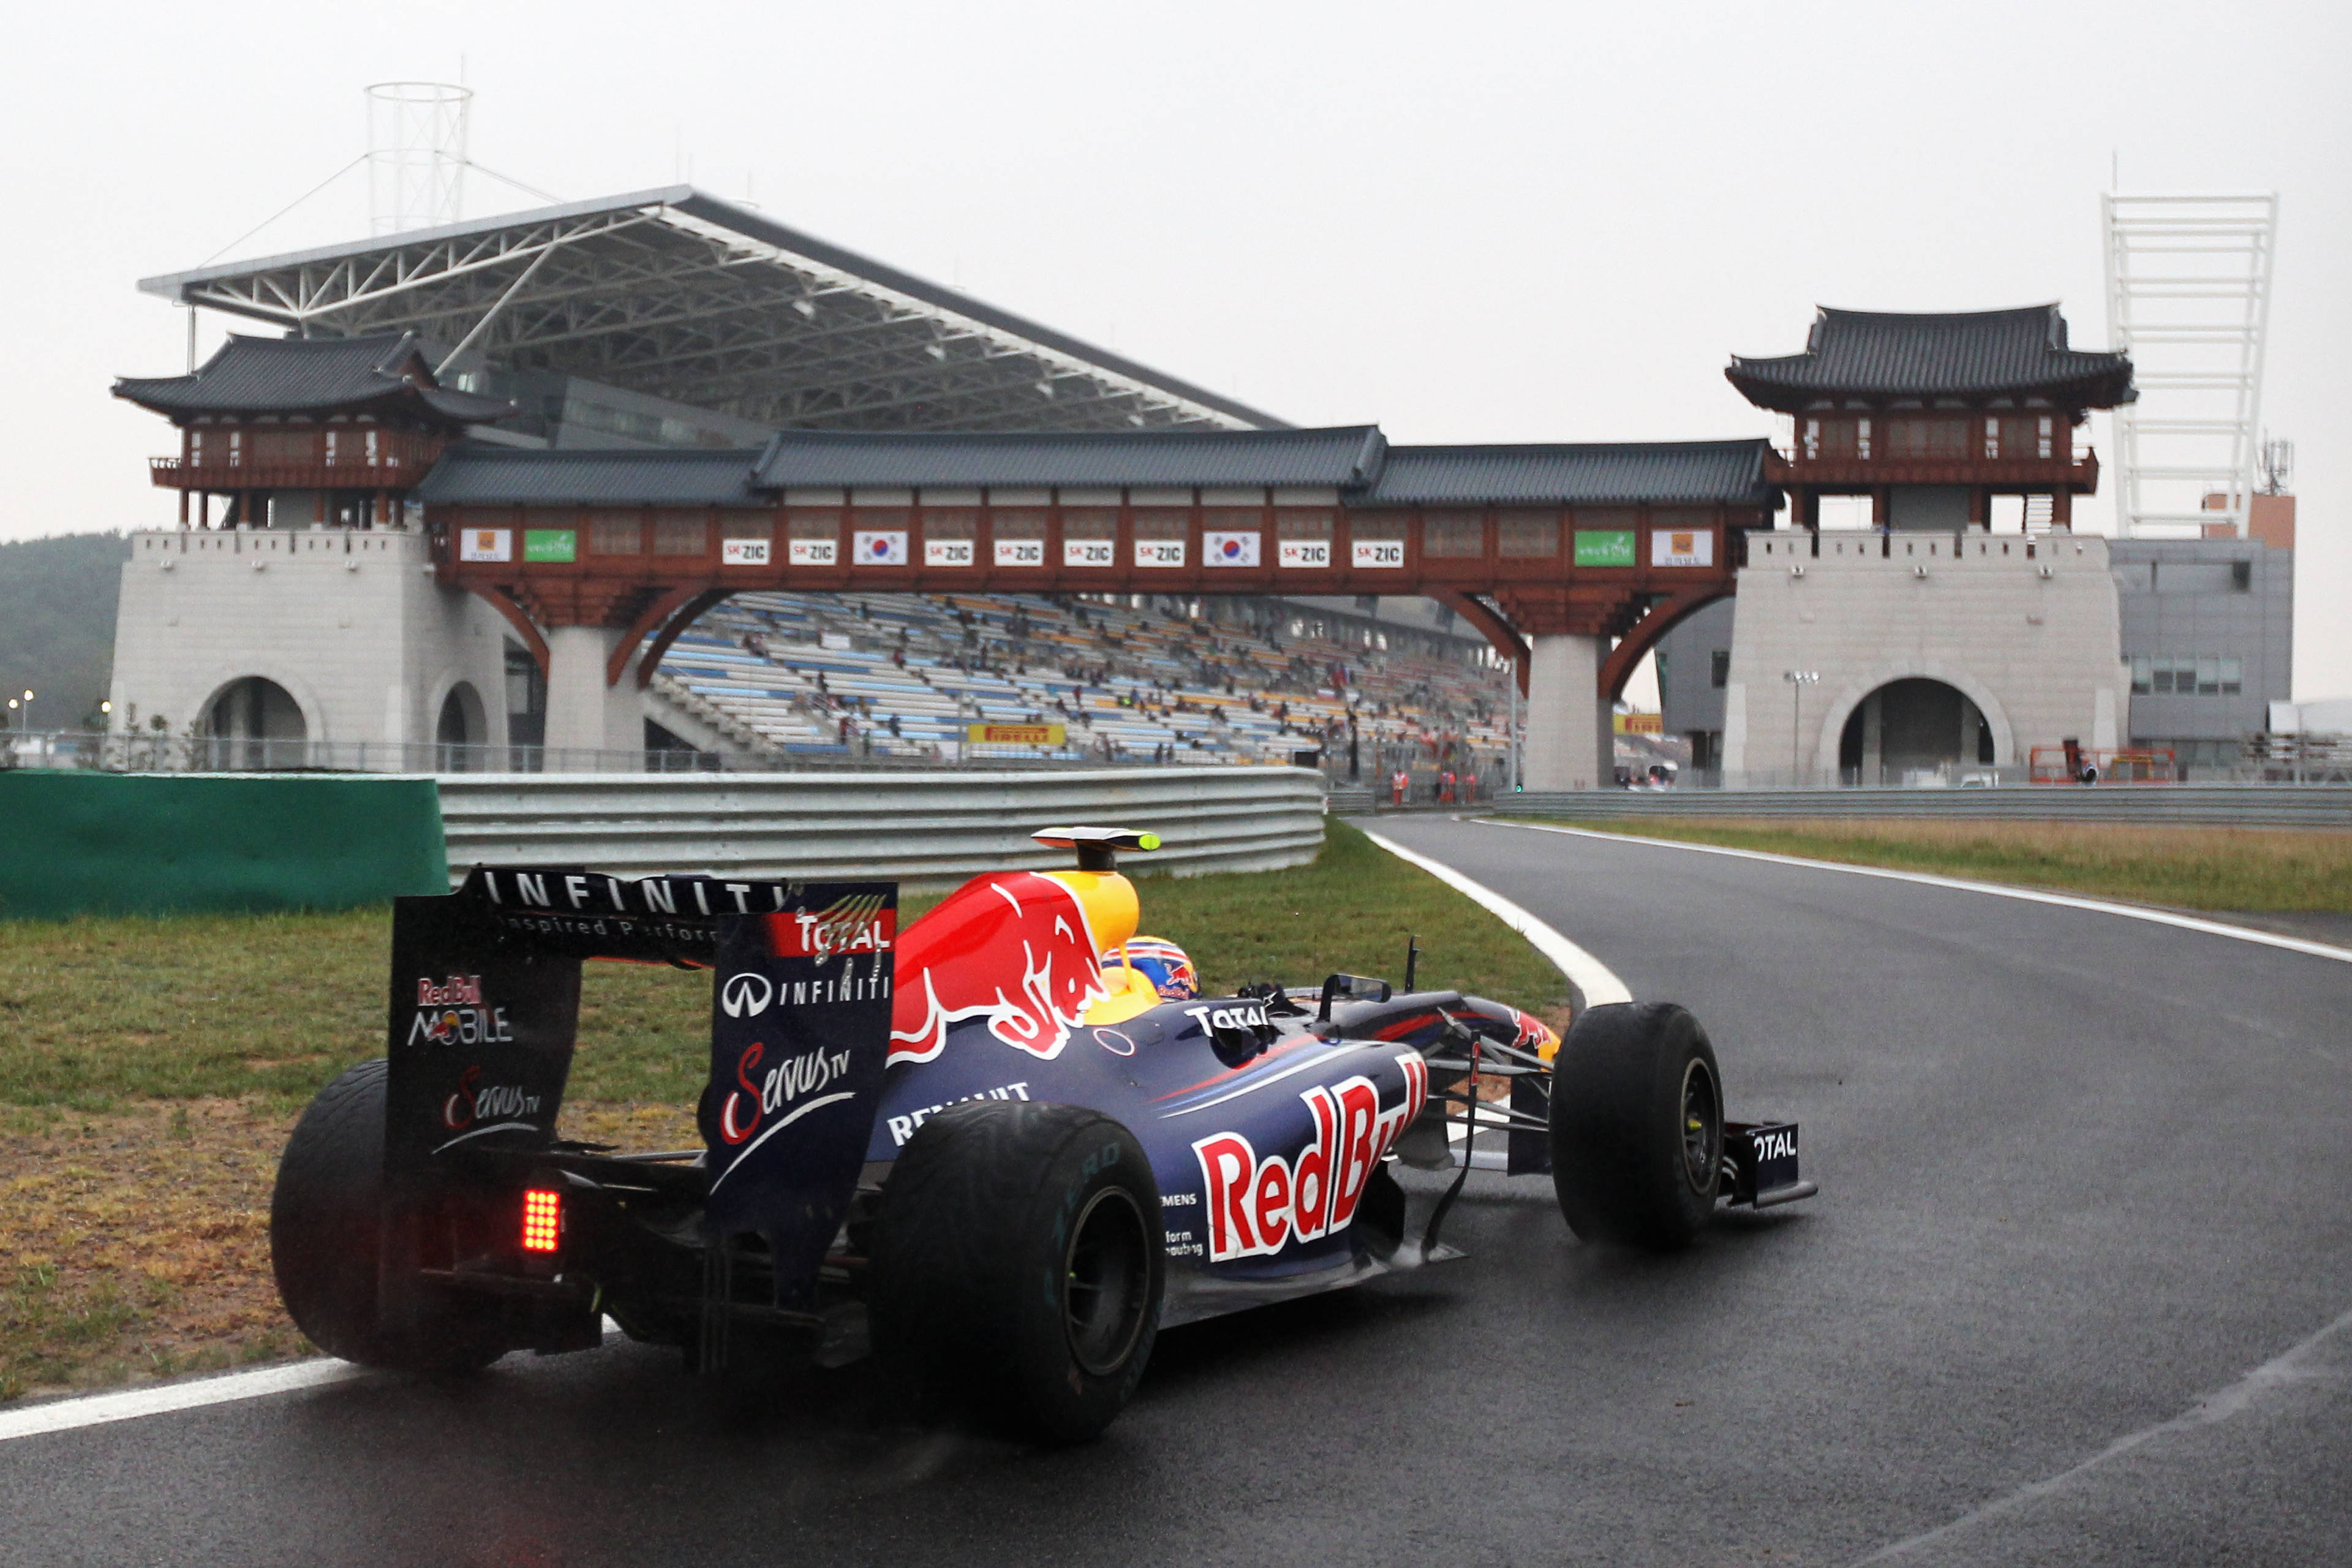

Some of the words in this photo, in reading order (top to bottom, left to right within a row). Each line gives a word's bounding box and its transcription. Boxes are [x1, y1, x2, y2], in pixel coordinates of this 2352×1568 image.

[1302, 548, 1325, 562] ZIC
[1375, 548, 1400, 562] ZIC
[484, 872, 786, 916] INFINITI
[497, 916, 608, 935] nspired
[780, 977, 889, 1005] INFINITI
[407, 1008, 513, 1046] MOBILE
[1754, 1131, 1796, 1163] OTAL
[1160, 1193, 1197, 1207] MENS
[1166, 1231, 1191, 1243] form
